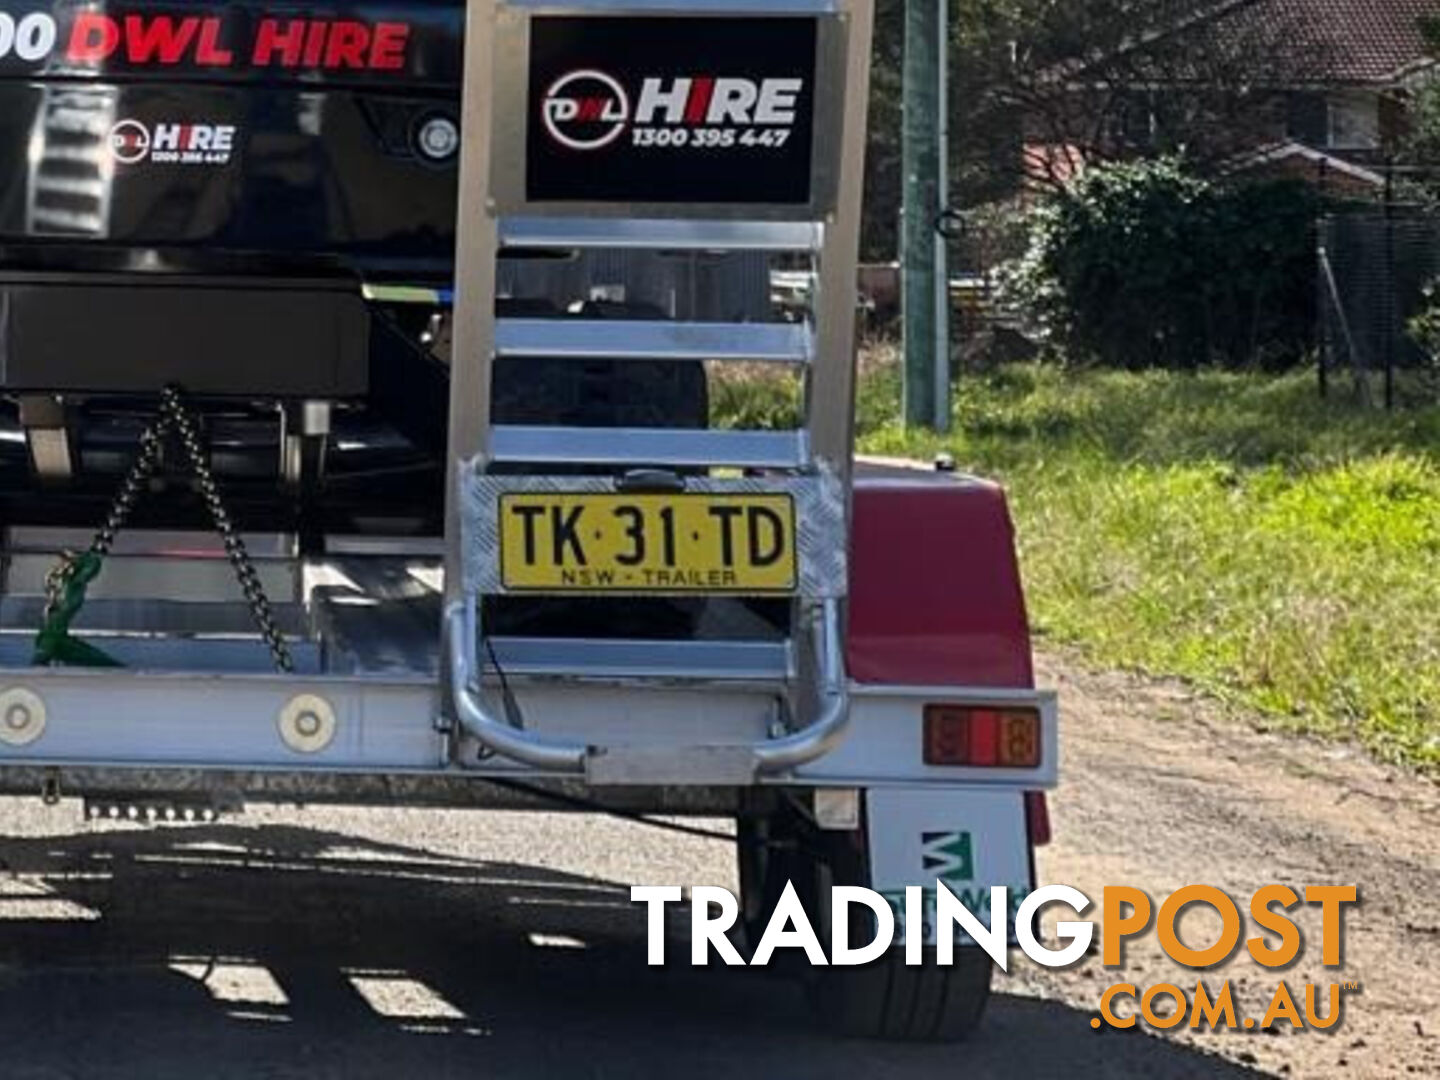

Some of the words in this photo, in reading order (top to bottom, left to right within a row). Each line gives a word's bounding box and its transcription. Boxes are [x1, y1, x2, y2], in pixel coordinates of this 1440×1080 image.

[66, 11, 232, 67] DWL
[252, 19, 410, 69] HIRE
[635, 77, 803, 125] HIRE
[152, 123, 235, 151] HIRE
[633, 128, 689, 146] 1300
[691, 129, 735, 147] 395
[739, 129, 790, 148] 447
[512, 506, 586, 566] TK
[614, 506, 675, 566] 31
[709, 507, 783, 567] TD
[562, 571, 616, 585] NSW
[644, 571, 737, 586] TRAILER
